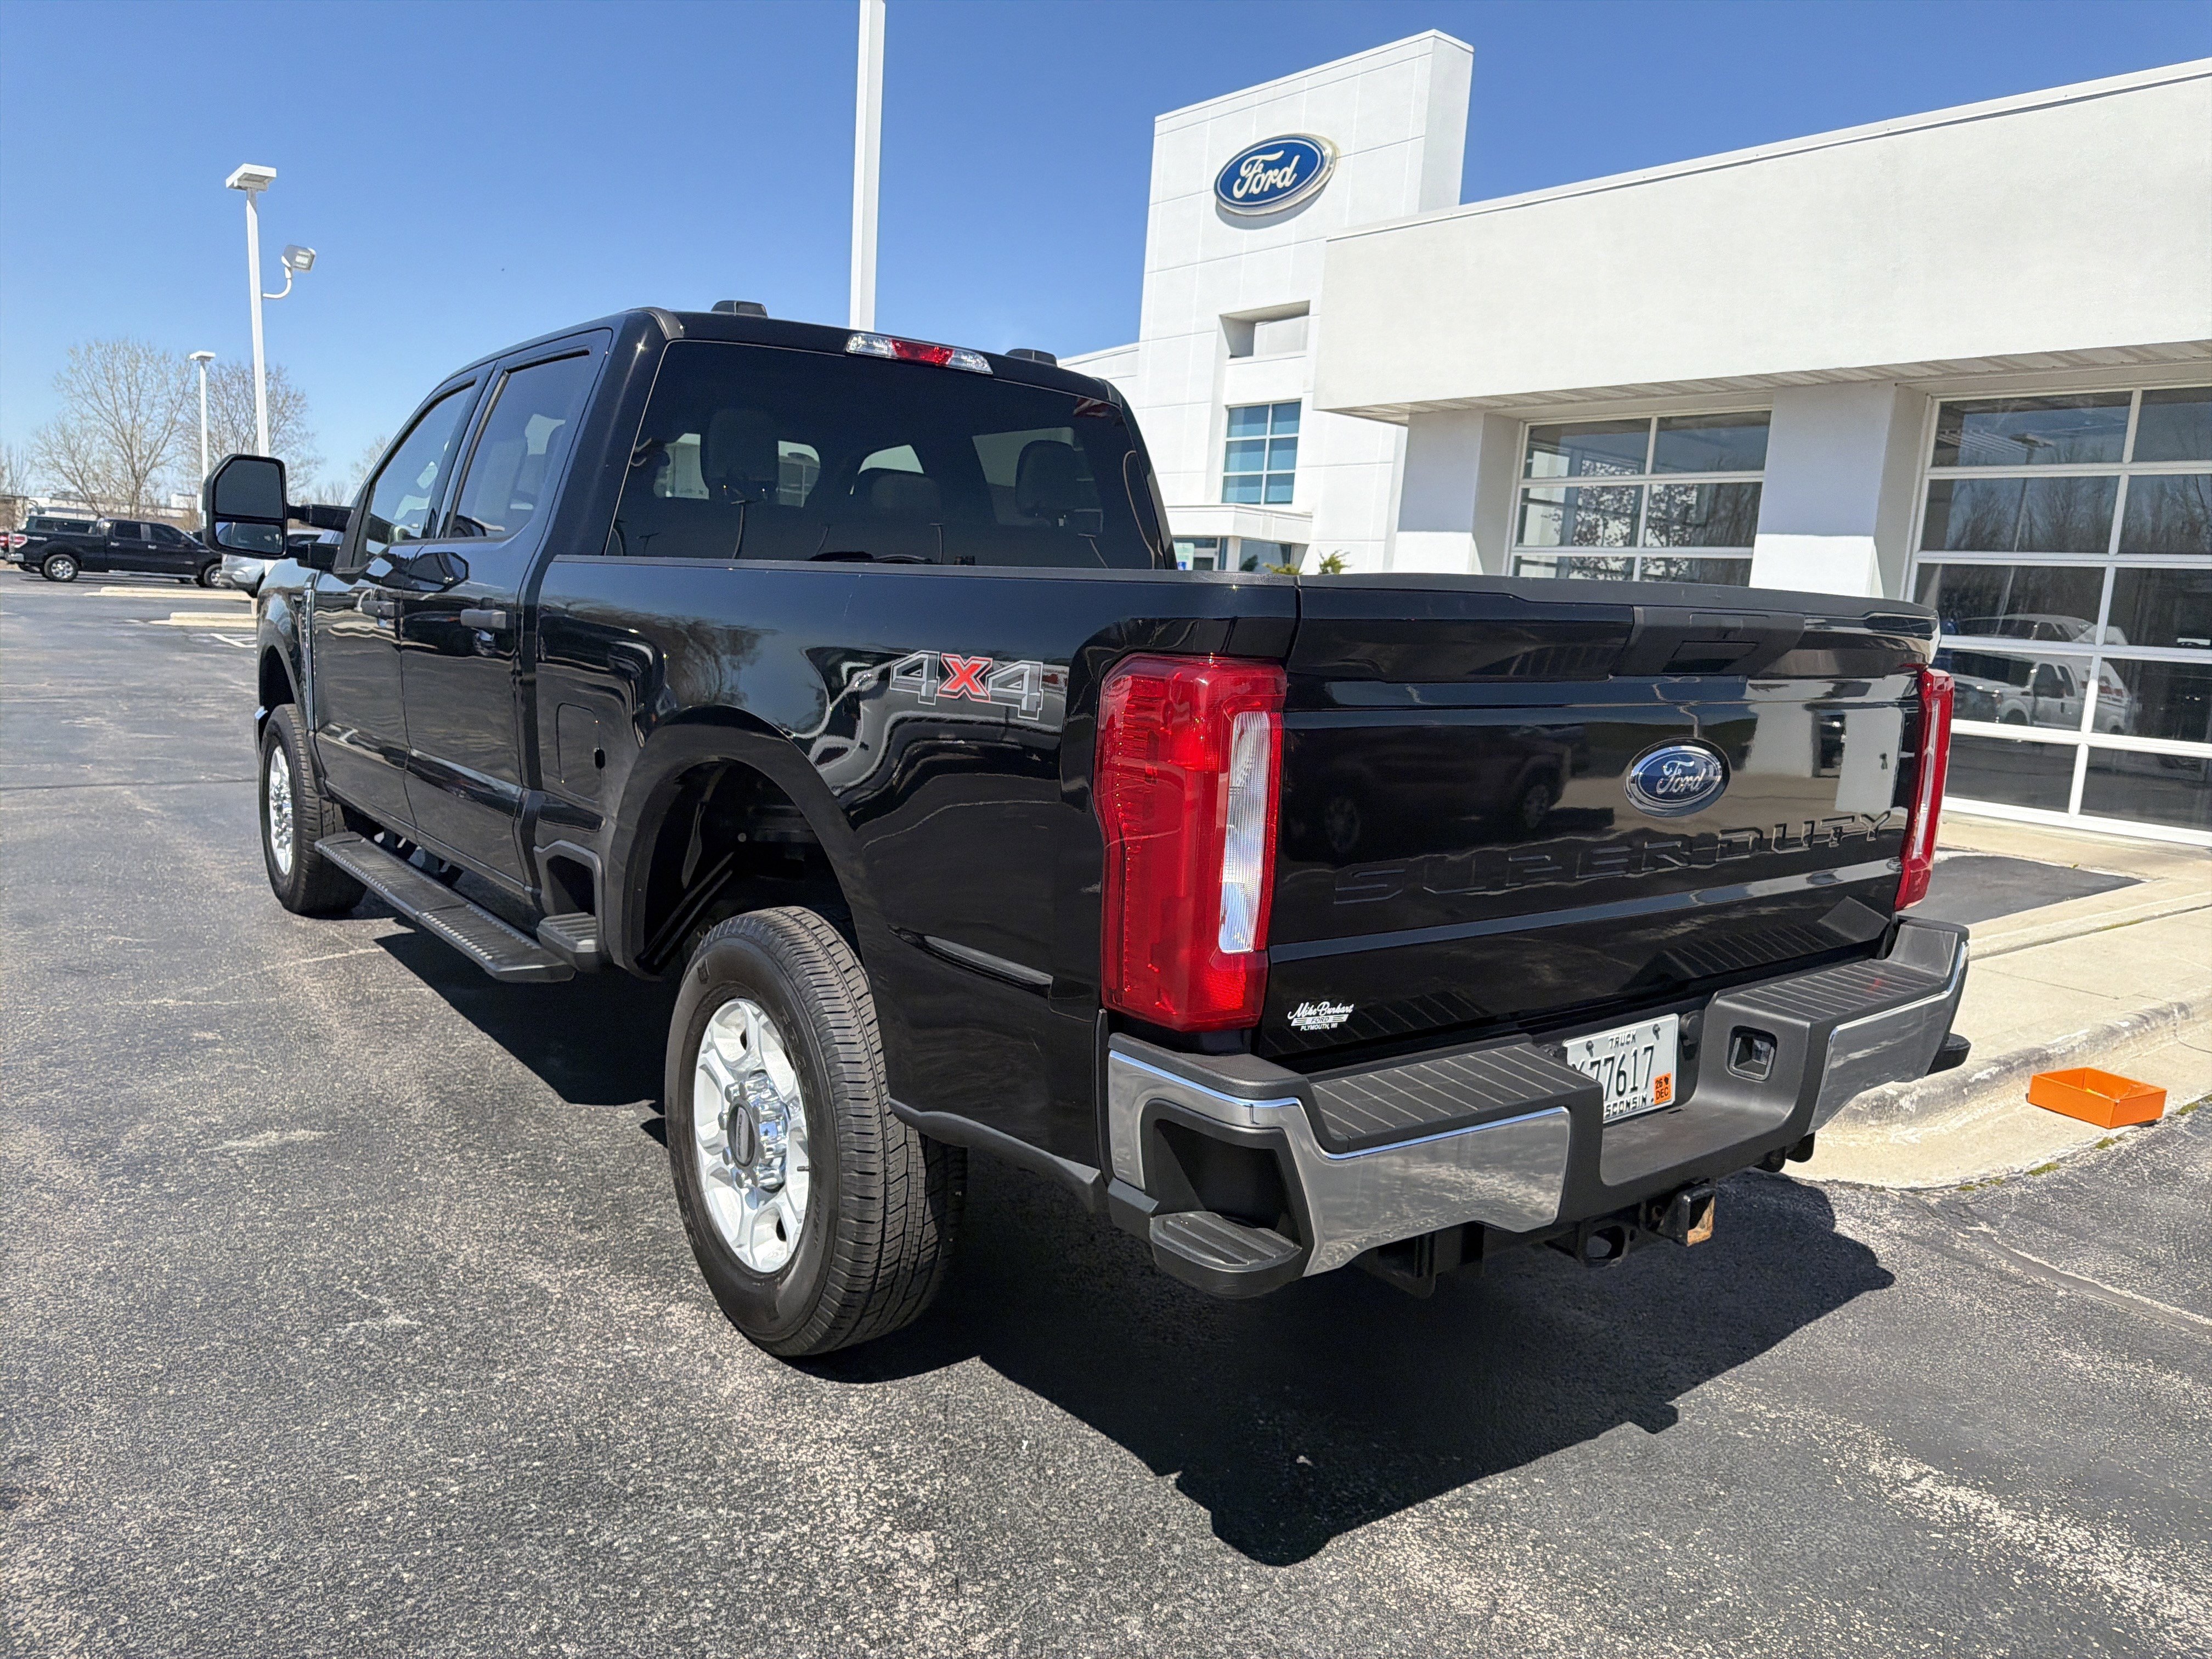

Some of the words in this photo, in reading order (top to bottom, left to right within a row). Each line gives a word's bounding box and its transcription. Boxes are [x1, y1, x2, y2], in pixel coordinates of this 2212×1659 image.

[1233, 150, 1300, 199] Ford
[1656, 760, 1707, 795] Ford
[1333, 835, 1692, 905] SUPER
[1716, 809, 1892, 862] DUTY
[1287, 1002, 1317, 1020] Mike
[1608, 1029, 1637, 1049] TRUCK
[1571, 1042, 1655, 1102] 77617
[1655, 1077, 1663, 1090] 26
[1604, 1091, 1647, 1119] SCONSIN
[1655, 1086, 1669, 1101] DEC
